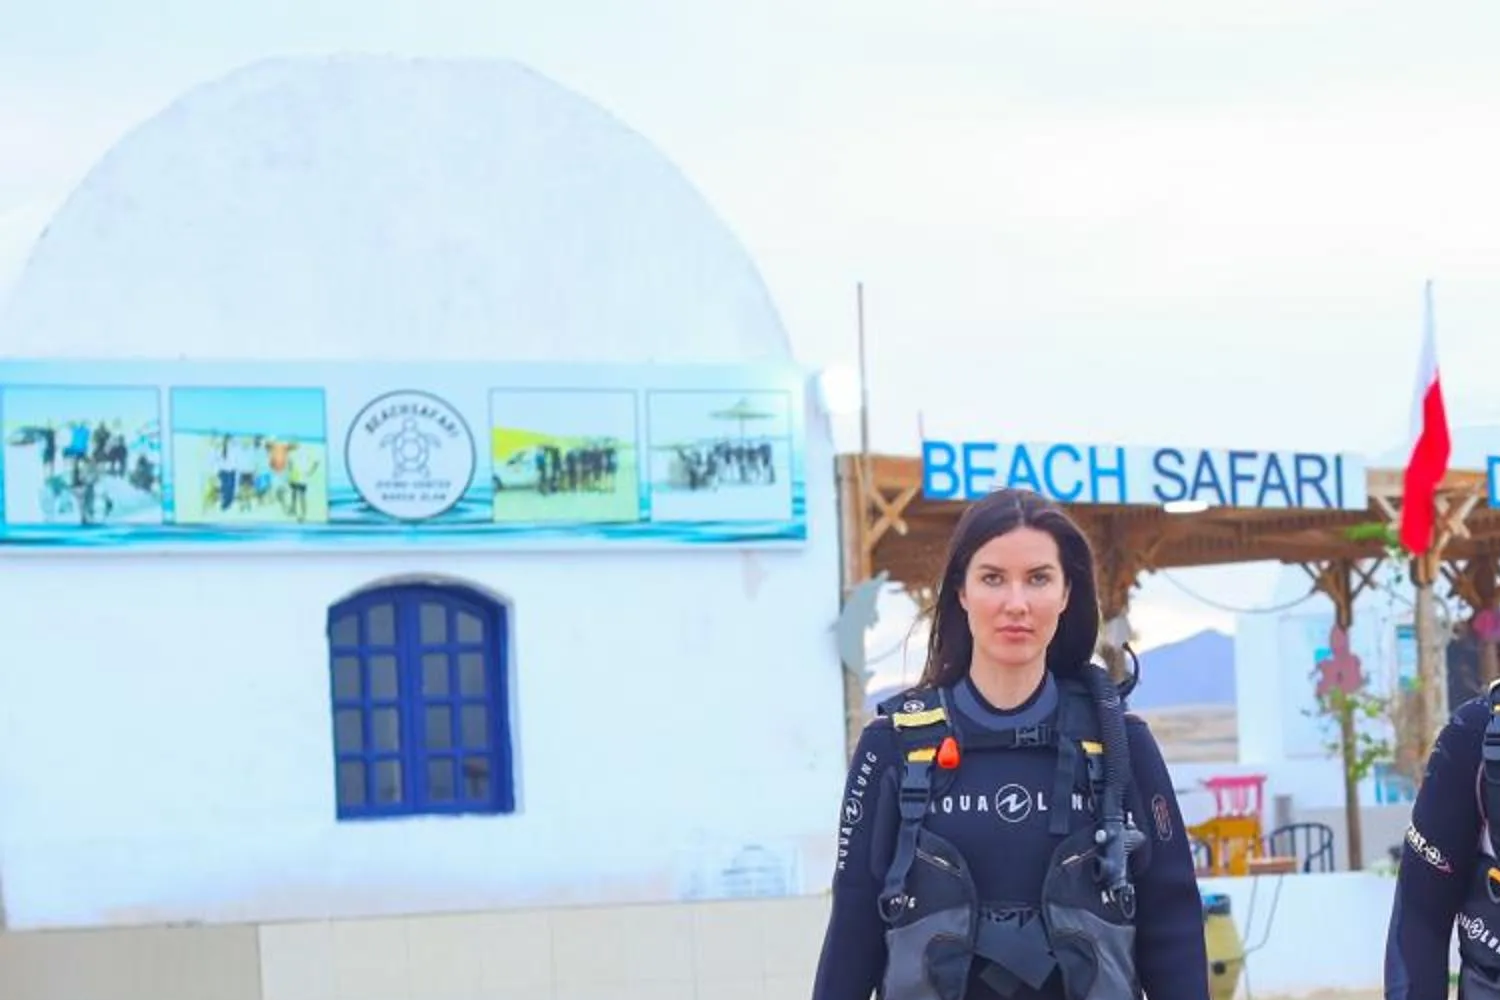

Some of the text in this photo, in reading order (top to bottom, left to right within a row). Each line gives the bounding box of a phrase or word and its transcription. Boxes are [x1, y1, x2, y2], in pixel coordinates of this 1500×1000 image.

[922, 440, 1343, 508] BEACH SAFARI
[851, 751, 878, 797] LUNG
